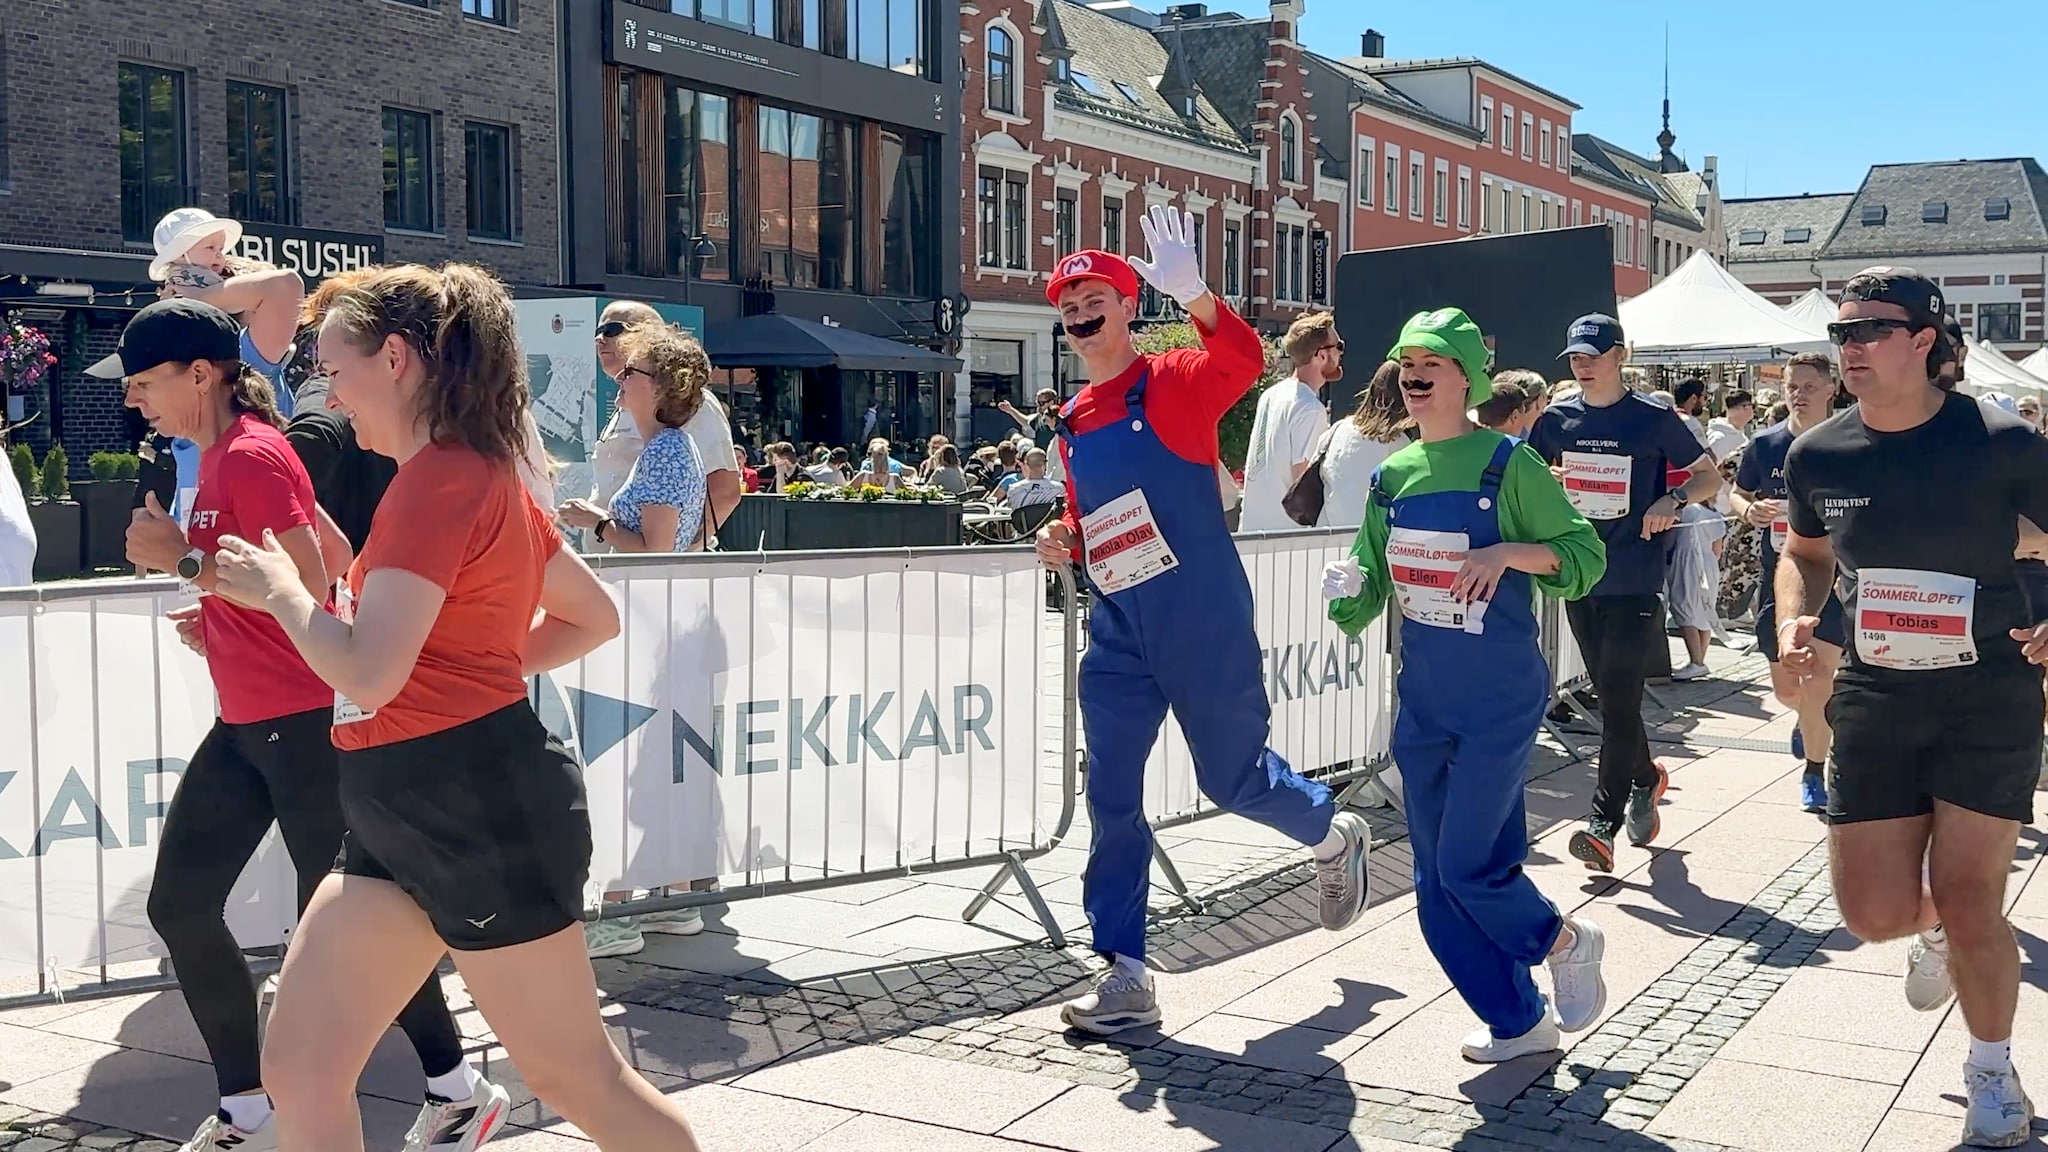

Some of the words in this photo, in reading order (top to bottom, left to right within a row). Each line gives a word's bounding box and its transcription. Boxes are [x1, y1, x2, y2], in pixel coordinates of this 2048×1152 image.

[1066, 257, 1089, 275] M
[1313, 239, 1324, 295] MONSOON
[1930, 295, 1940, 313] FJ
[1086, 505, 1142, 541] SOMMERLØPET
[1090, 539, 1124, 562] Nikolai
[1126, 525, 1154, 544] Olav
[1409, 569, 1438, 585] Ellen
[1862, 588, 1965, 604] SOMMERLØPET
[1886, 613, 1939, 629] Tobias
[1863, 631, 1886, 641] 1498
[1261, 635, 1364, 704] KKAR
[672, 684, 996, 784] NEKKAR
